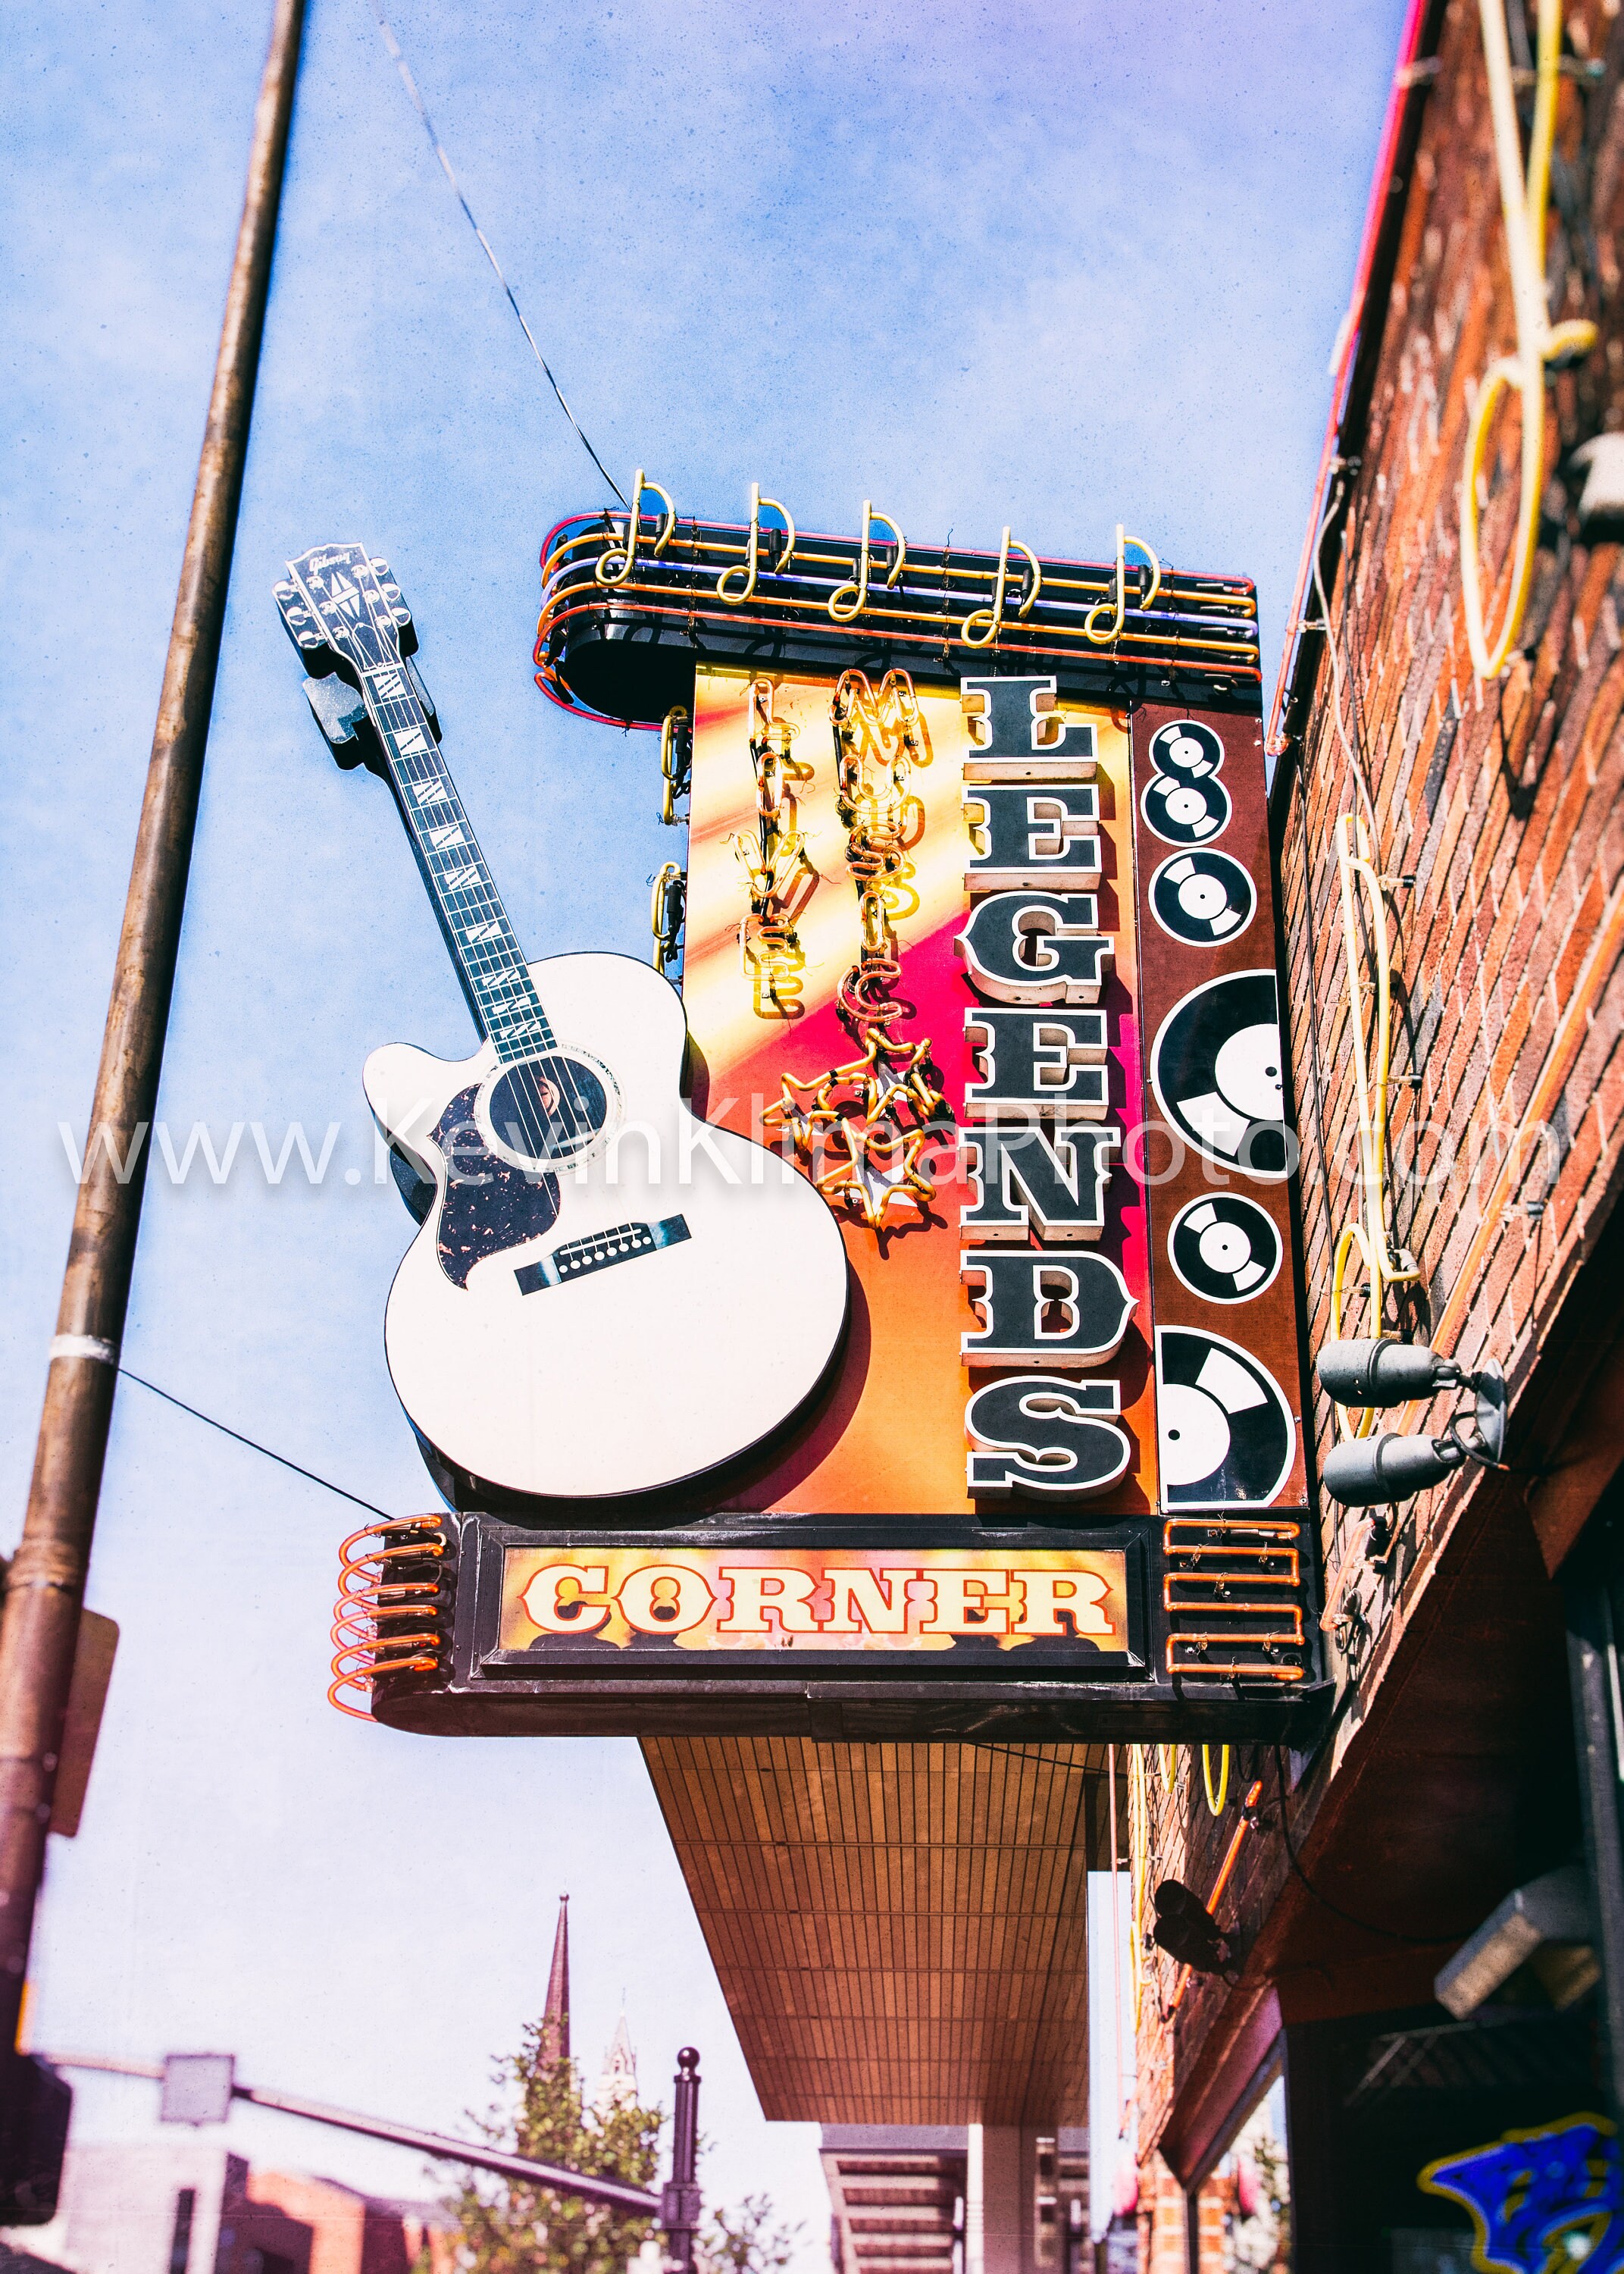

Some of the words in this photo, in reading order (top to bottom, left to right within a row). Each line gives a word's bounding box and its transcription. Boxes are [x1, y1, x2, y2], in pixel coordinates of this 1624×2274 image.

[732, 677, 806, 981] LIVE
[828, 668, 919, 1023] MUSIC
[953, 675, 1140, 1496] LEGENDS
[516, 1563, 1116, 1636] CORNER
